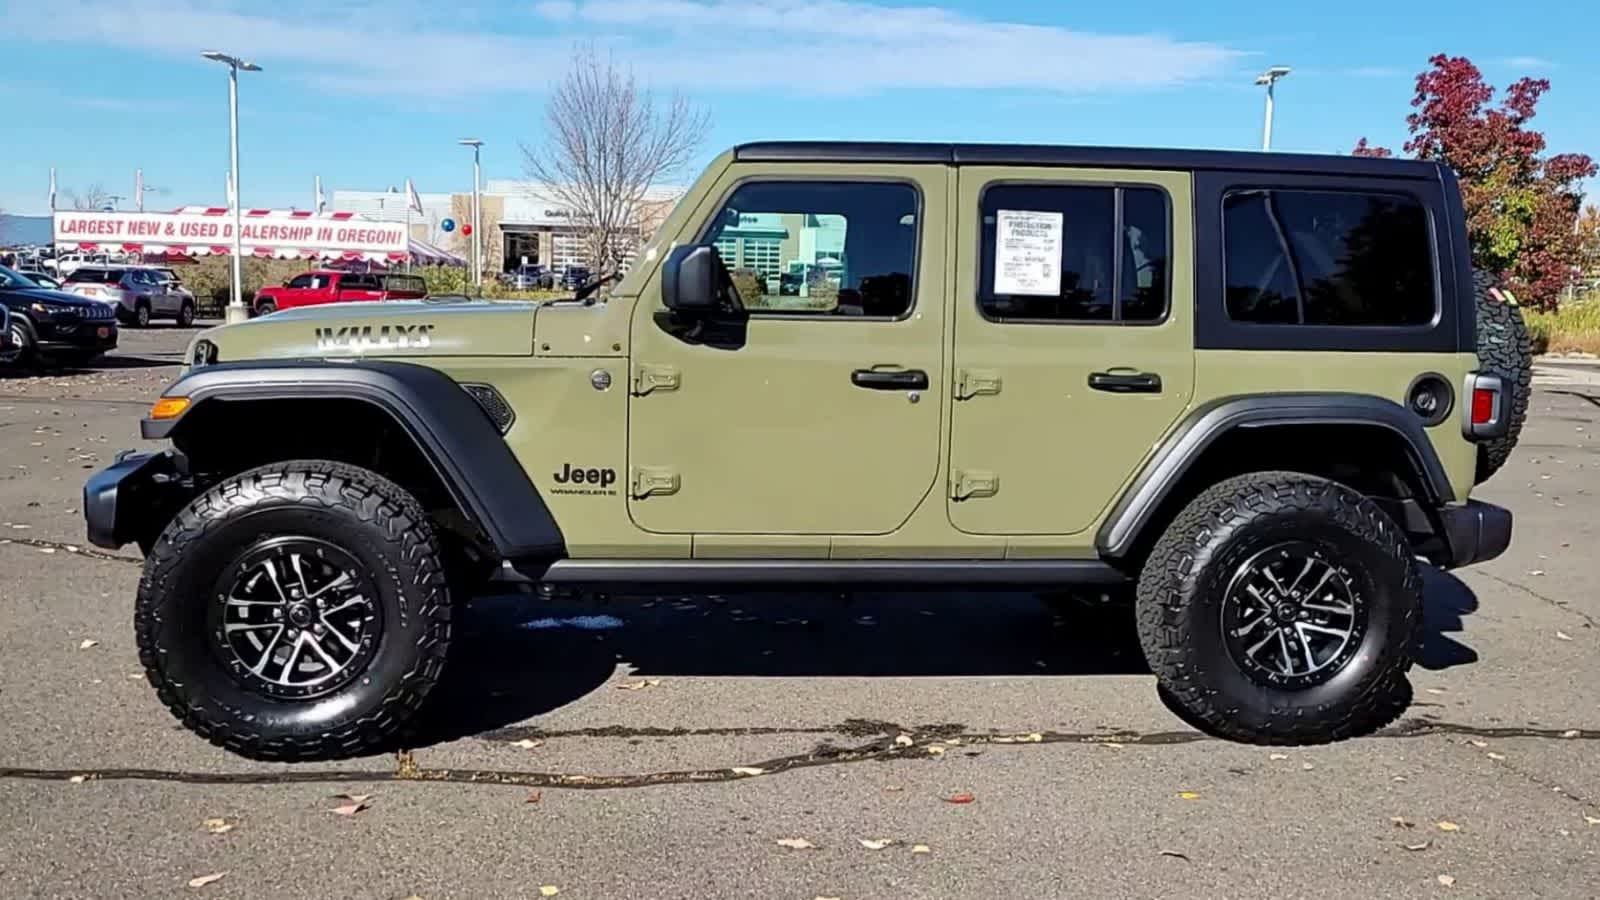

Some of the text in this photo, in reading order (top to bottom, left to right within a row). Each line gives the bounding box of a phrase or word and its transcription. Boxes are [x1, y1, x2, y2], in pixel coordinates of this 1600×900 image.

[60, 219, 402, 244] LARGEST NEW & USED DALERSHIP IN OREGON!
[315, 325, 434, 351] WILLYS
[553, 463, 616, 488] Jeep
